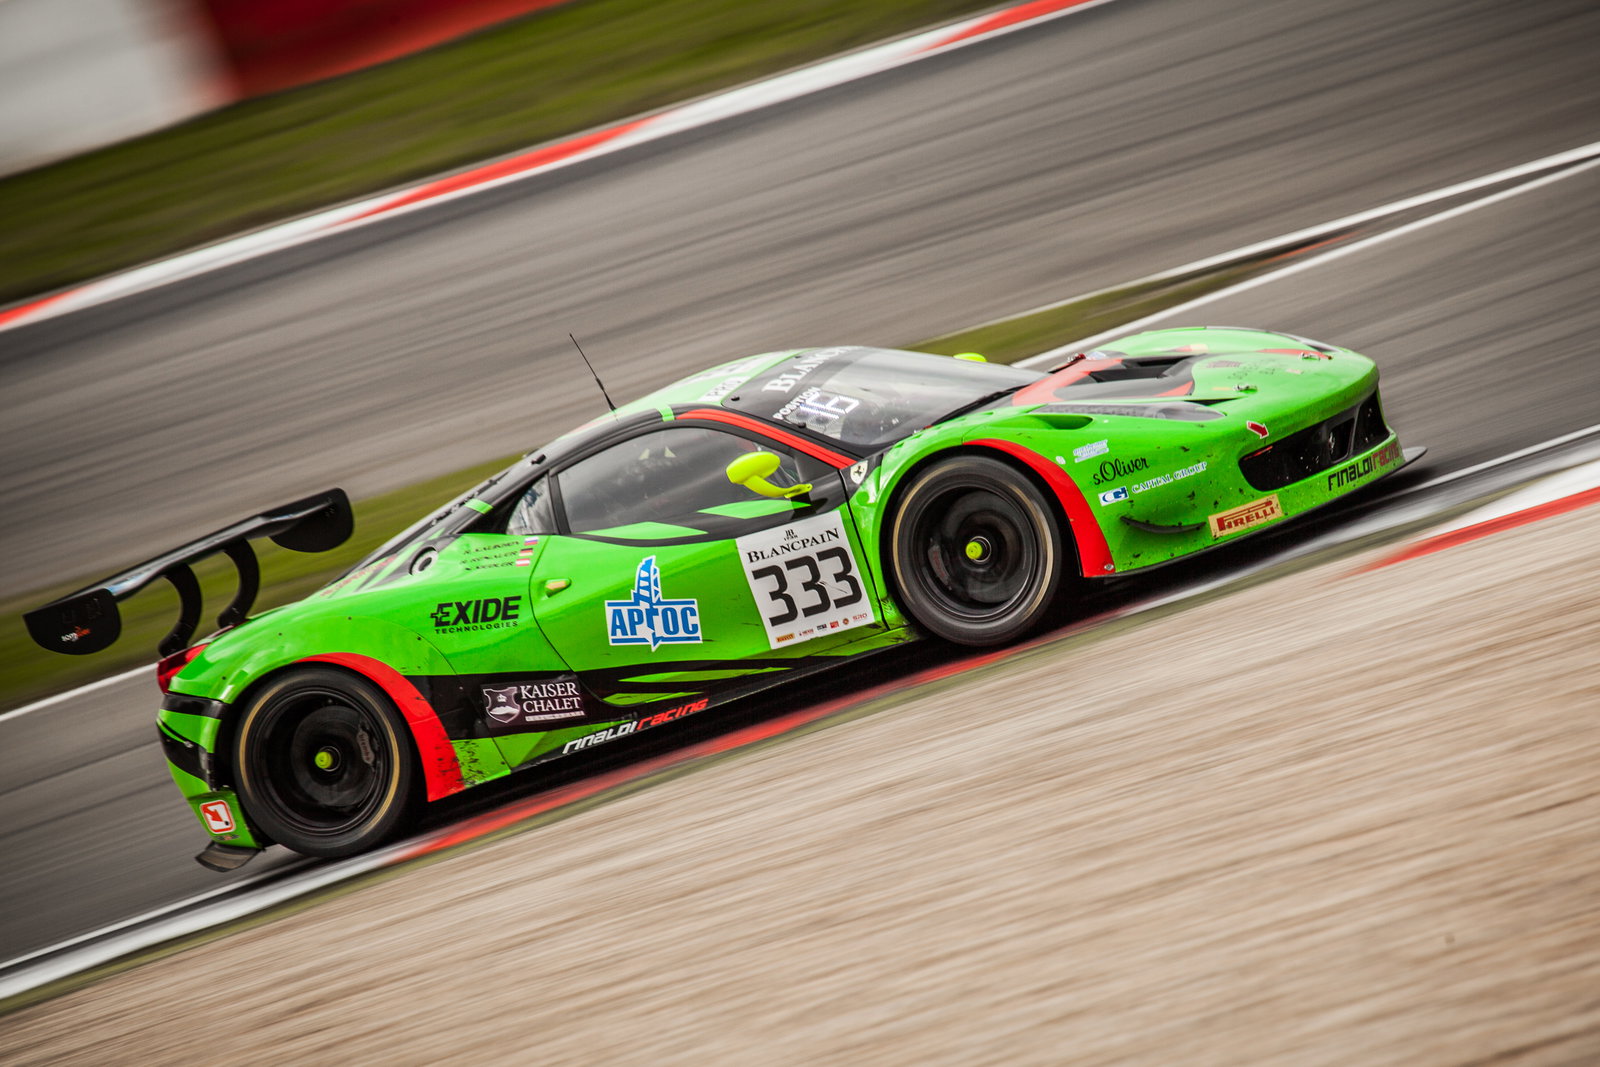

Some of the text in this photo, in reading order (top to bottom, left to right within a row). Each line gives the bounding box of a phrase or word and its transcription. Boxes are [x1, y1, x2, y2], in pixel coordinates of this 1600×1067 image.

[1093, 457, 1150, 485] s.Oliver
[1132, 474, 1173, 494] CAPITAL
[1173, 461, 1207, 480] GROUP
[1216, 500, 1276, 532] PIRELLI
[747, 528, 840, 563] BLANCPAIN
[752, 546, 863, 627] 333
[430, 595, 522, 628] EXIDE
[435, 621, 518, 635] TECHNOLOGIES
[520, 682, 580, 700] KAISER
[522, 697, 582, 714] CHALET
